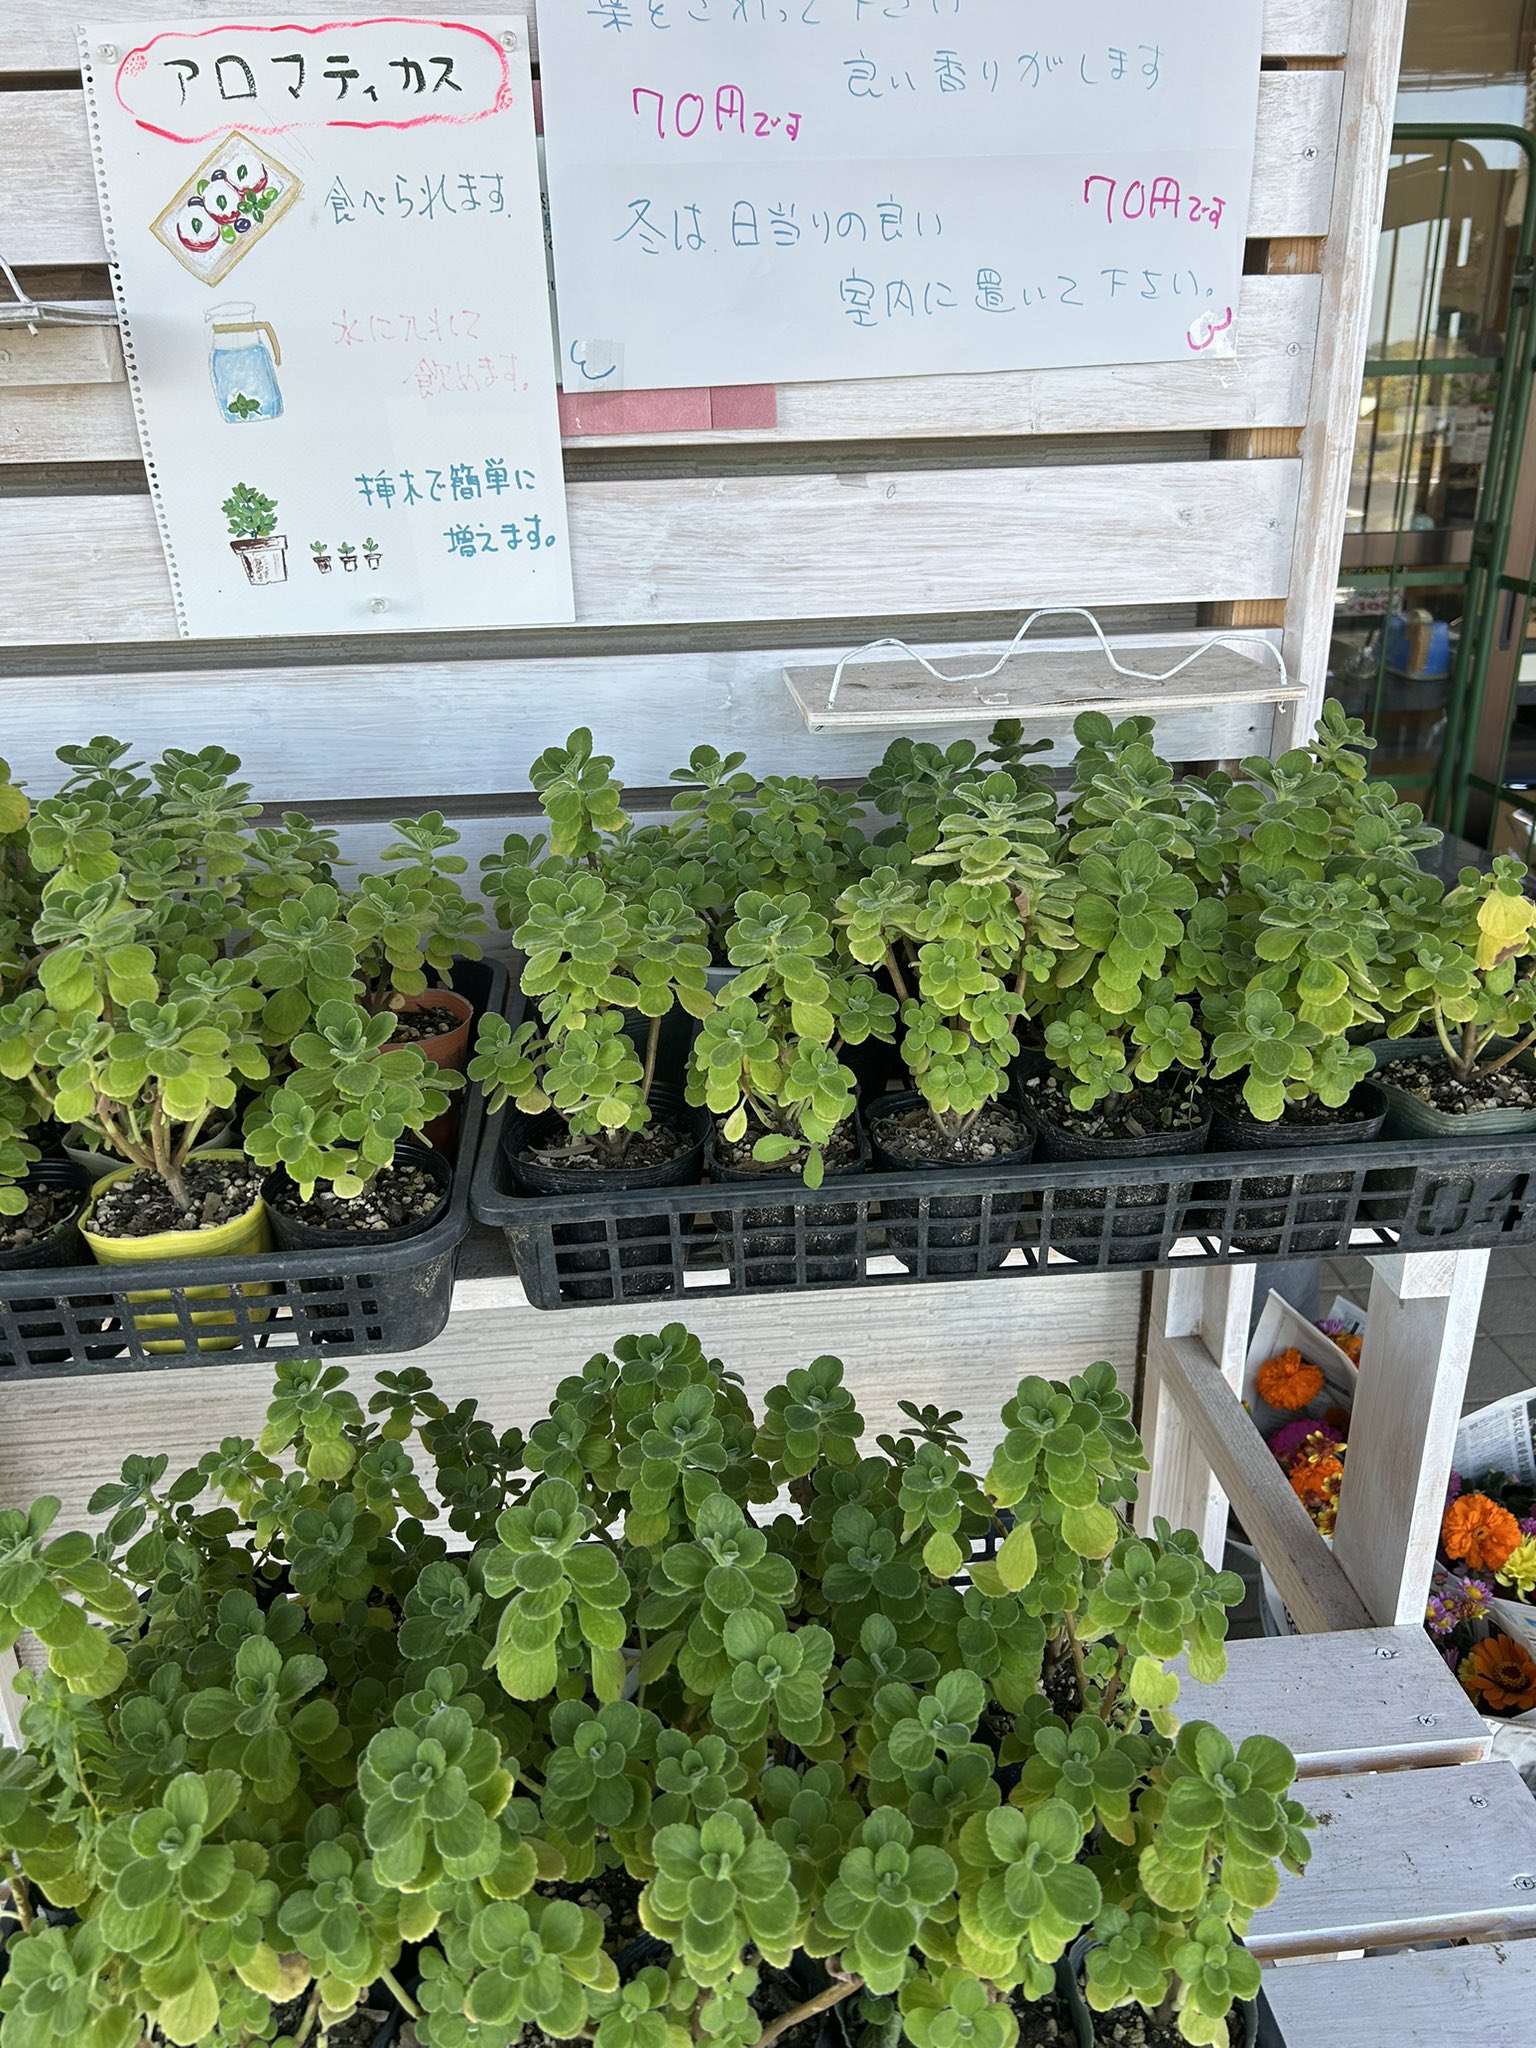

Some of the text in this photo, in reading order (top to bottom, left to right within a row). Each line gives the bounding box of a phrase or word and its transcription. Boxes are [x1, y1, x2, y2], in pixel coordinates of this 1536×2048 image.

[164, 54, 463, 106] アロマティカス
[843, 45, 1164, 98] 良い香りがします
[632, 84, 802, 141] 70円です
[1084, 175, 1226, 230] 70円です
[443, 514, 556, 558] 増えます。
